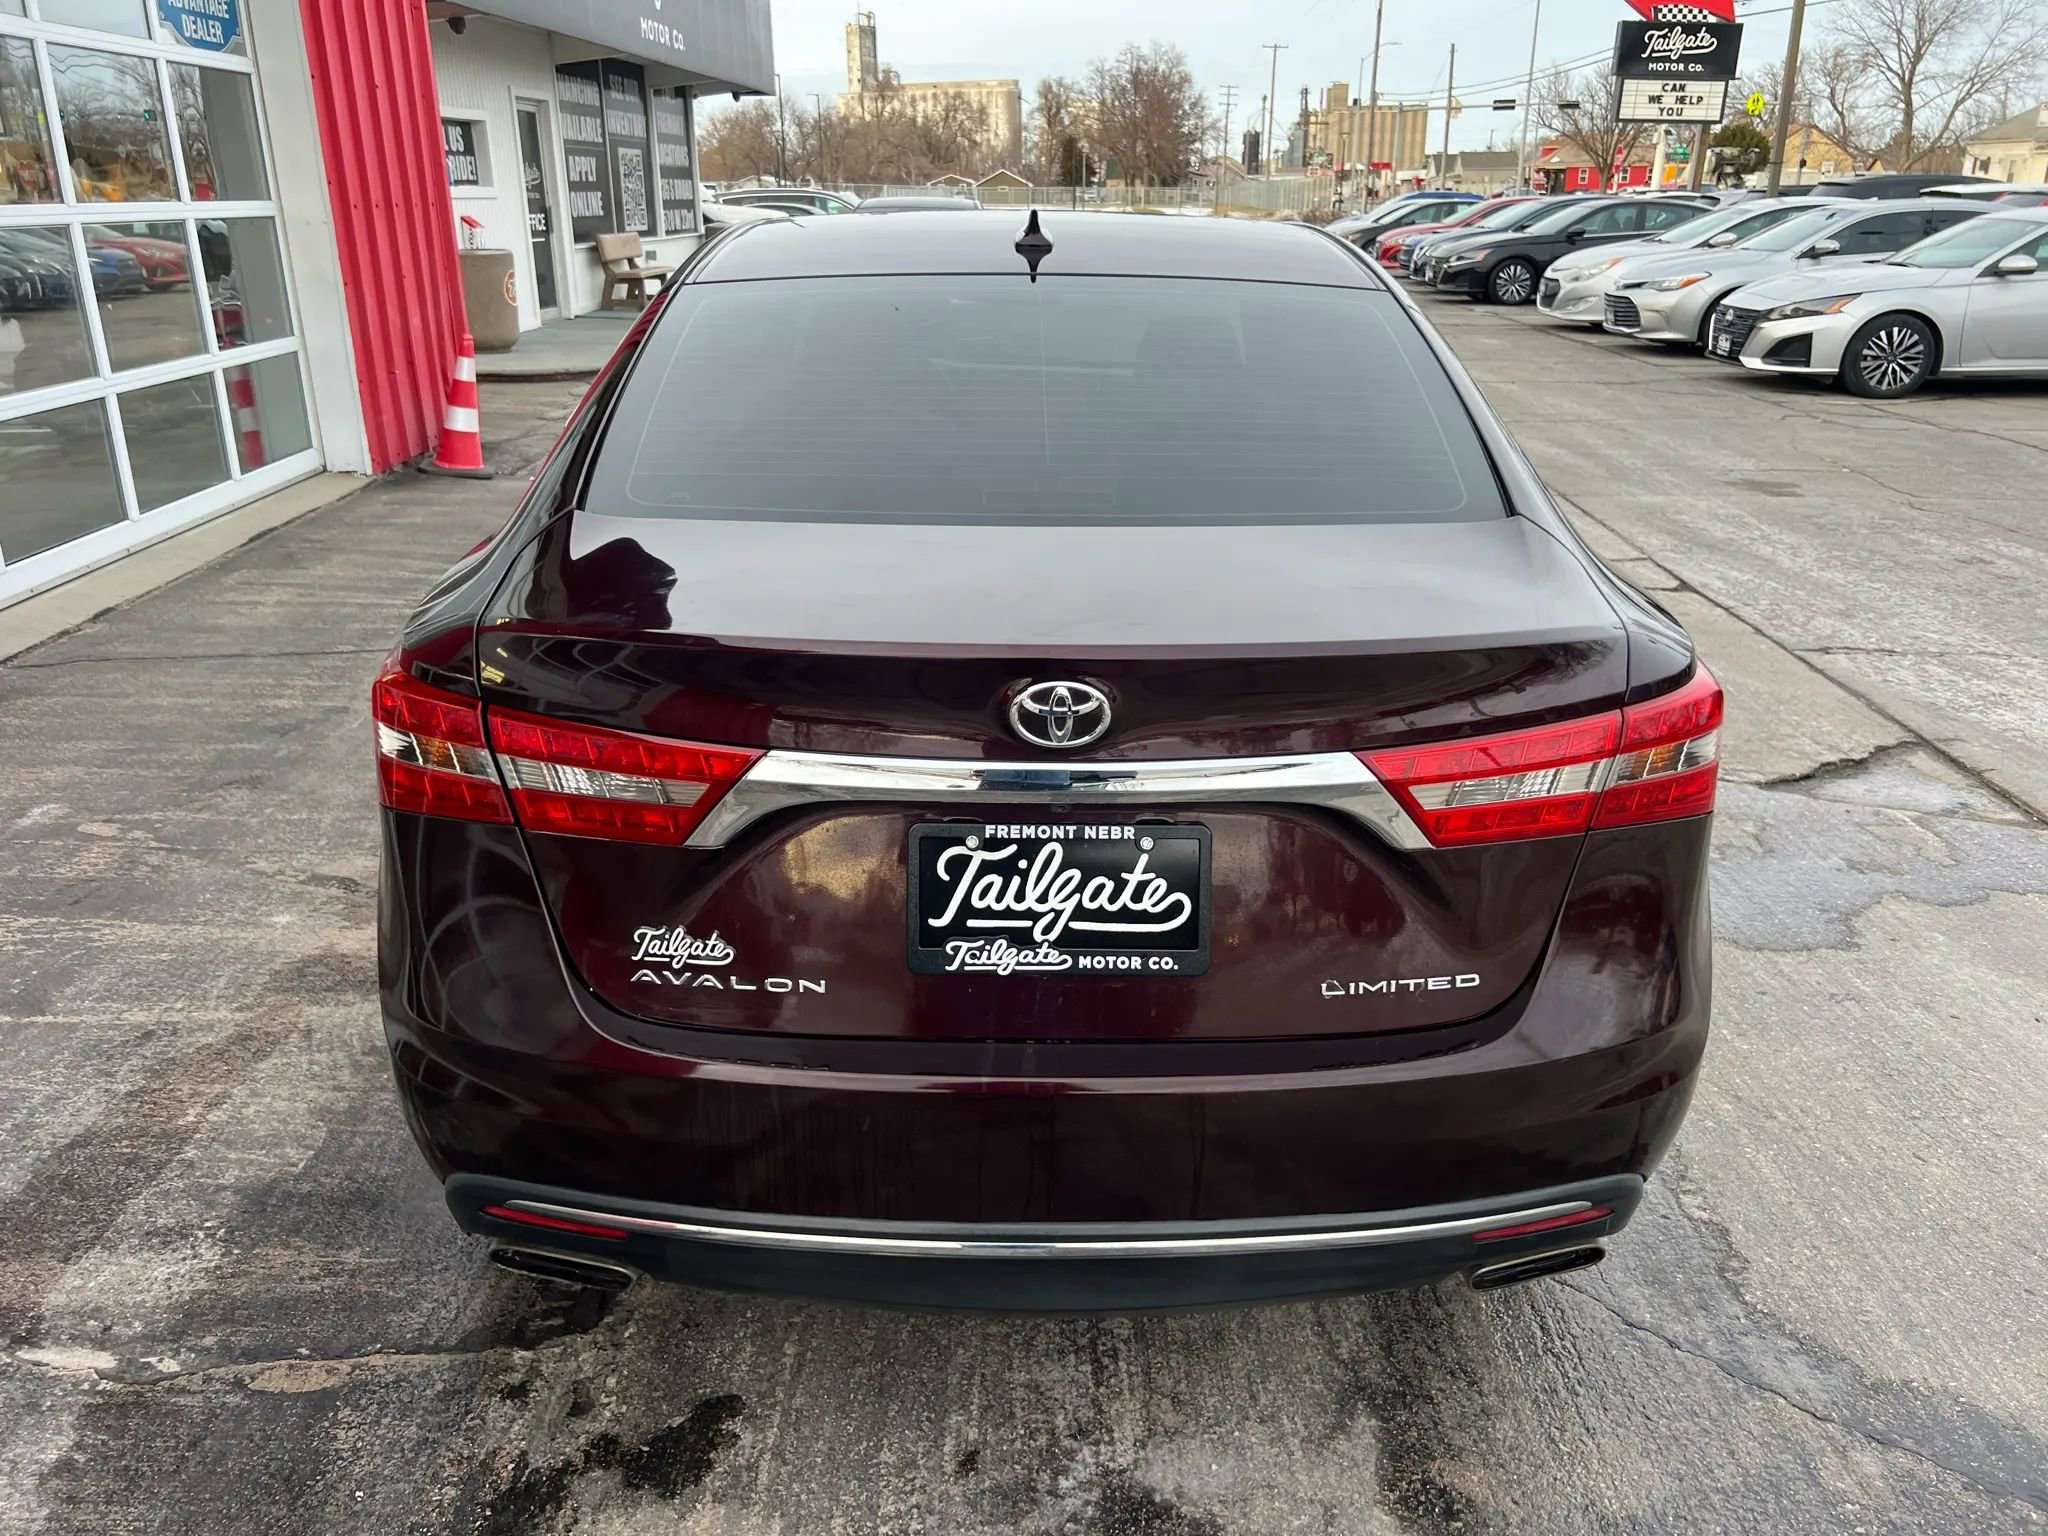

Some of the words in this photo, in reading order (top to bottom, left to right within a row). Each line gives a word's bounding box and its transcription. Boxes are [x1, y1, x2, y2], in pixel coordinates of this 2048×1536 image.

[181, 14, 225, 44] DEALER
[640, 16, 671, 47] MOTOR
[672, 29, 686, 51] CO.
[1640, 26, 1718, 60] Tailgate
[1648, 62, 1685, 72] MOTOR
[1688, 63, 1705, 72] CO.
[557, 73, 600, 107] NANCING
[1648, 95, 1664, 105] WE
[1675, 95, 1704, 105] HELP
[1661, 83, 1687, 93] CAN
[1659, 107, 1684, 117] YOU
[448, 125, 465, 153] US
[559, 112, 603, 143] VAILABLE
[448, 155, 478, 181] RIDE!
[568, 155, 597, 182] APPLY
[570, 191, 604, 218] ONLINE
[528, 213, 547, 231] FFICE
[984, 824, 1077, 840] FREMONT
[1084, 825, 1136, 840] NEBR
[927, 841, 1192, 942] Tailgate
[631, 927, 735, 969] Tailgate
[945, 938, 1073, 976] Tailgate
[1078, 956, 1142, 970] MOTOR
[1149, 956, 1179, 970] CO.
[630, 969, 827, 994] AVALON
[1320, 973, 1481, 996] LIMITED
